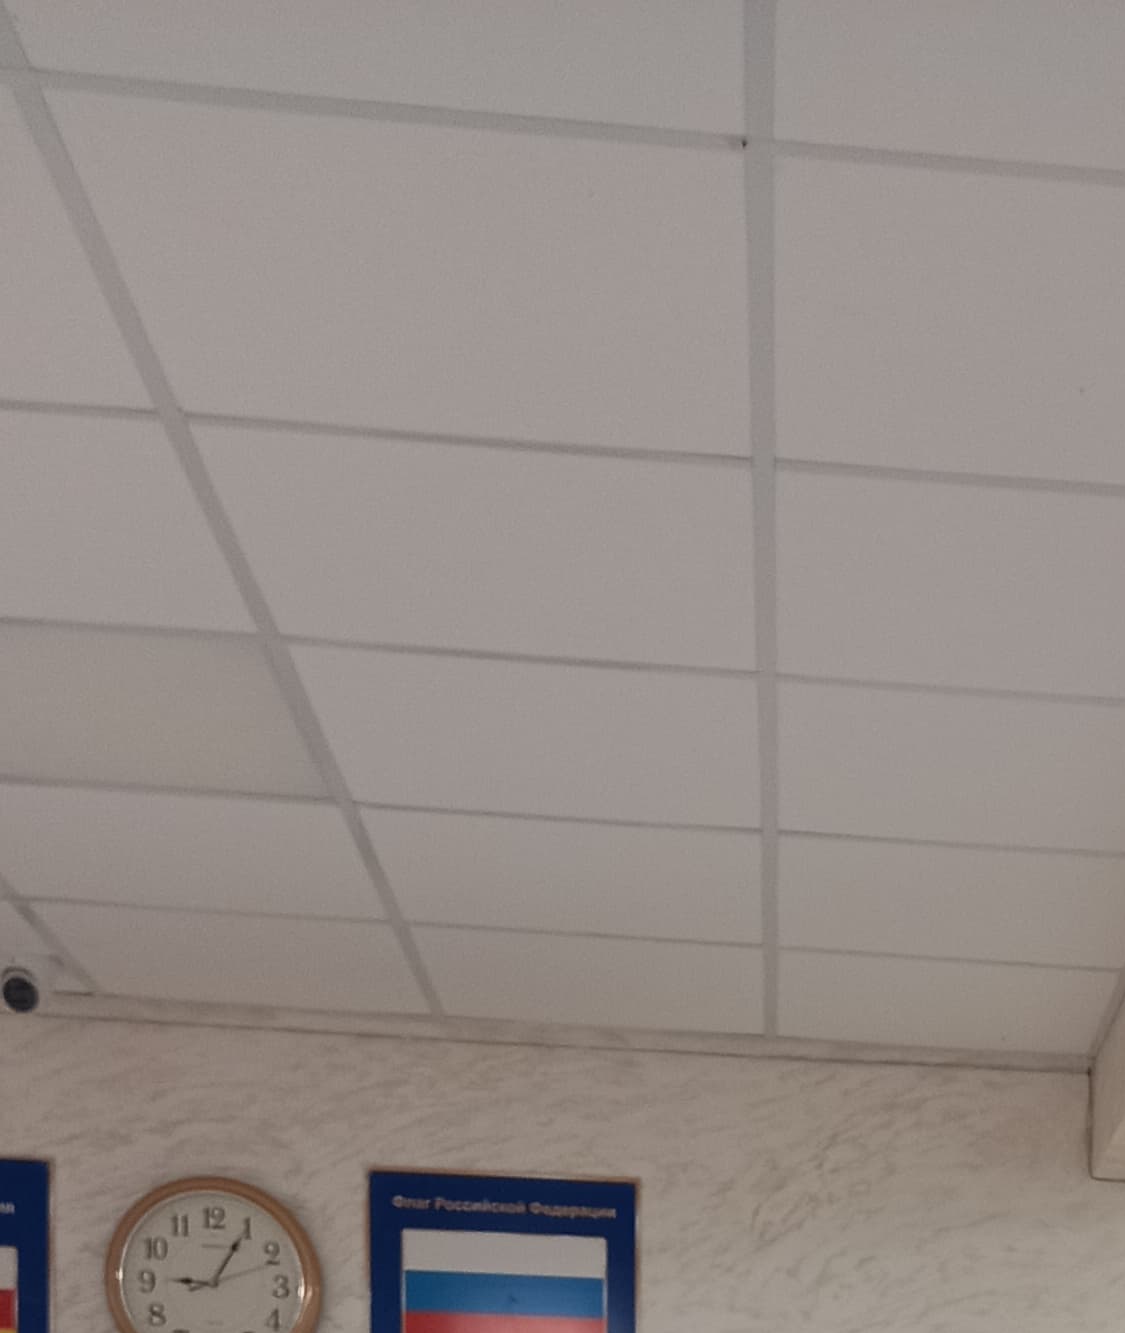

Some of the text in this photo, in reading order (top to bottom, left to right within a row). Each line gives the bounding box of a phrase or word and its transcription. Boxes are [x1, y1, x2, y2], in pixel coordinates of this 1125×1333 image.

[171, 1214, 189, 1237] 11
[203, 1206, 226, 1230] 12
[144, 1236, 169, 1261] 10
[264, 1241, 281, 1266] 2
[138, 1270, 156, 1294] 9
[272, 1274, 290, 1299] 3
[149, 1304, 167, 1327] 8
[264, 1308, 281, 1332] 4
